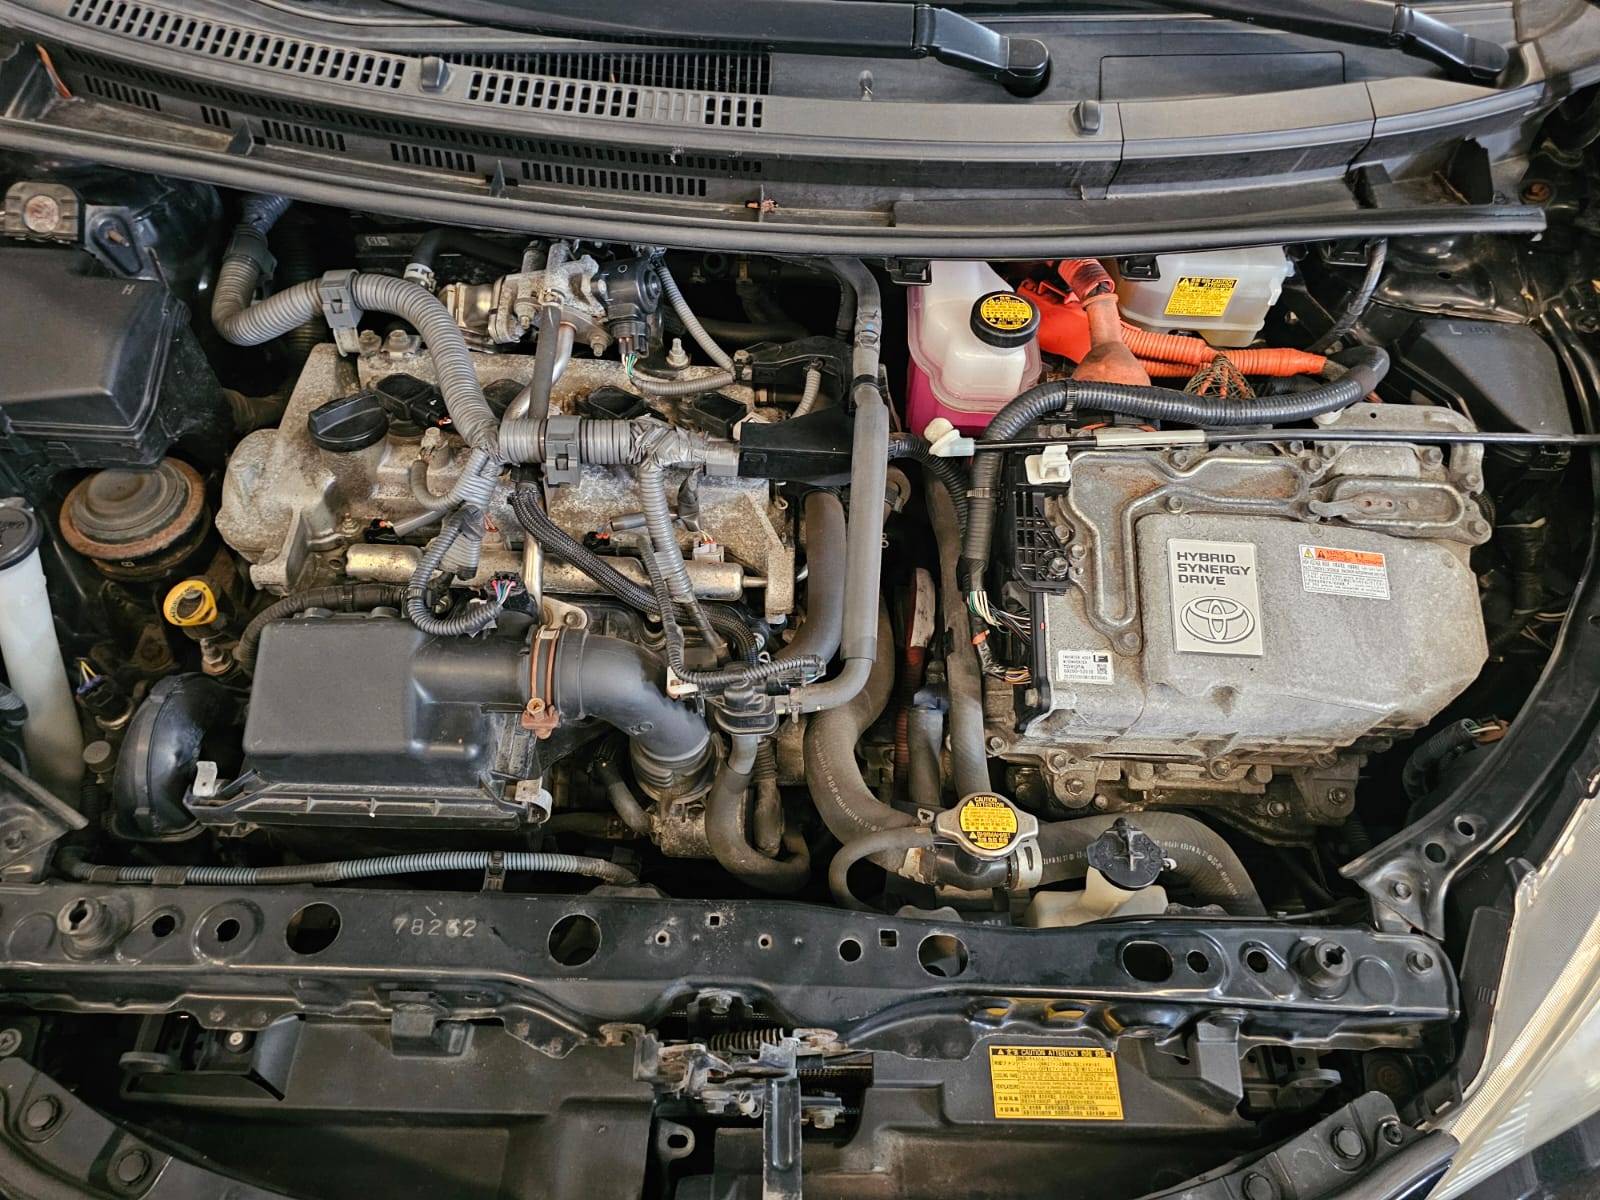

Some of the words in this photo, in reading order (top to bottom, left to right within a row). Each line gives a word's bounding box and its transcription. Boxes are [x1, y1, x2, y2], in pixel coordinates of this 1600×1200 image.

[1176, 551, 1236, 563] HYBRID
[1177, 563, 1251, 576] SYNERGY
[1178, 574, 1226, 586] DRIVE
[1048, 1049, 1079, 1057] ATTENTION
